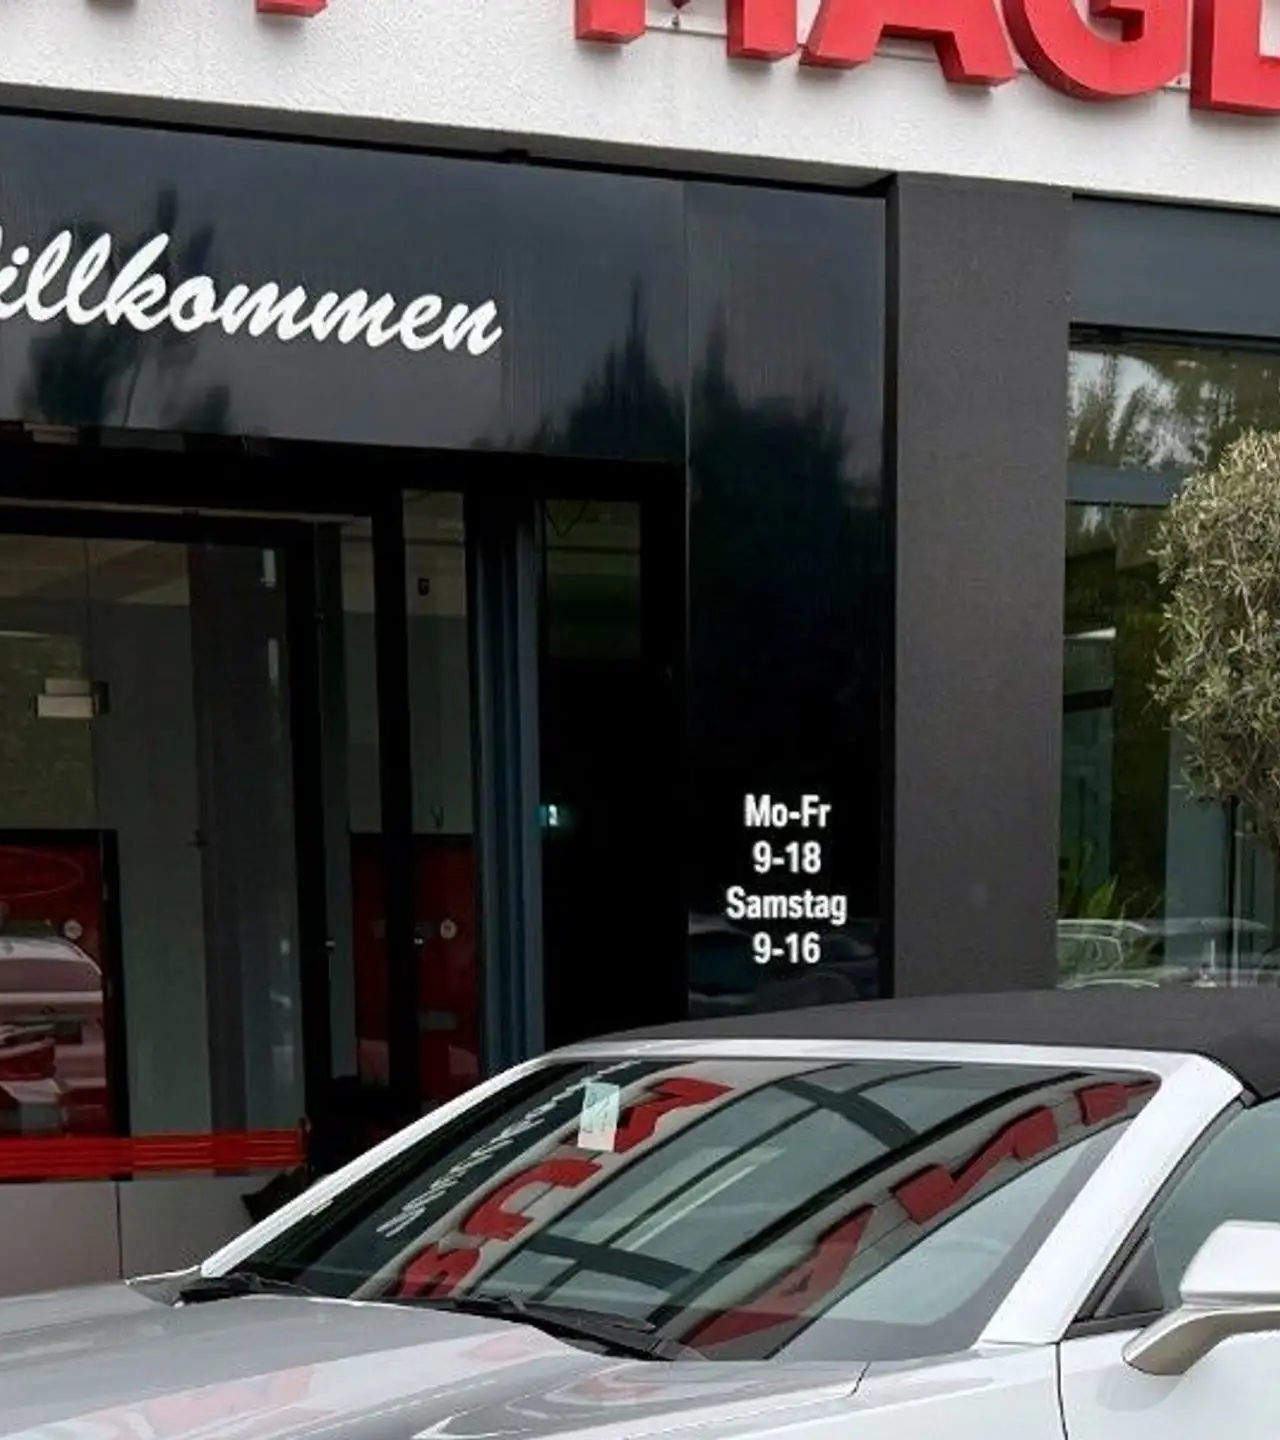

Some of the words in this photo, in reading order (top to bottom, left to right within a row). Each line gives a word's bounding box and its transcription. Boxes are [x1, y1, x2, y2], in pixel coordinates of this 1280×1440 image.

[744, 793, 831, 827] Mo-Fr
[752, 840, 821, 873] 9-18
[726, 885, 847, 926] Samstag
[752, 931, 821, 964] 9-16
